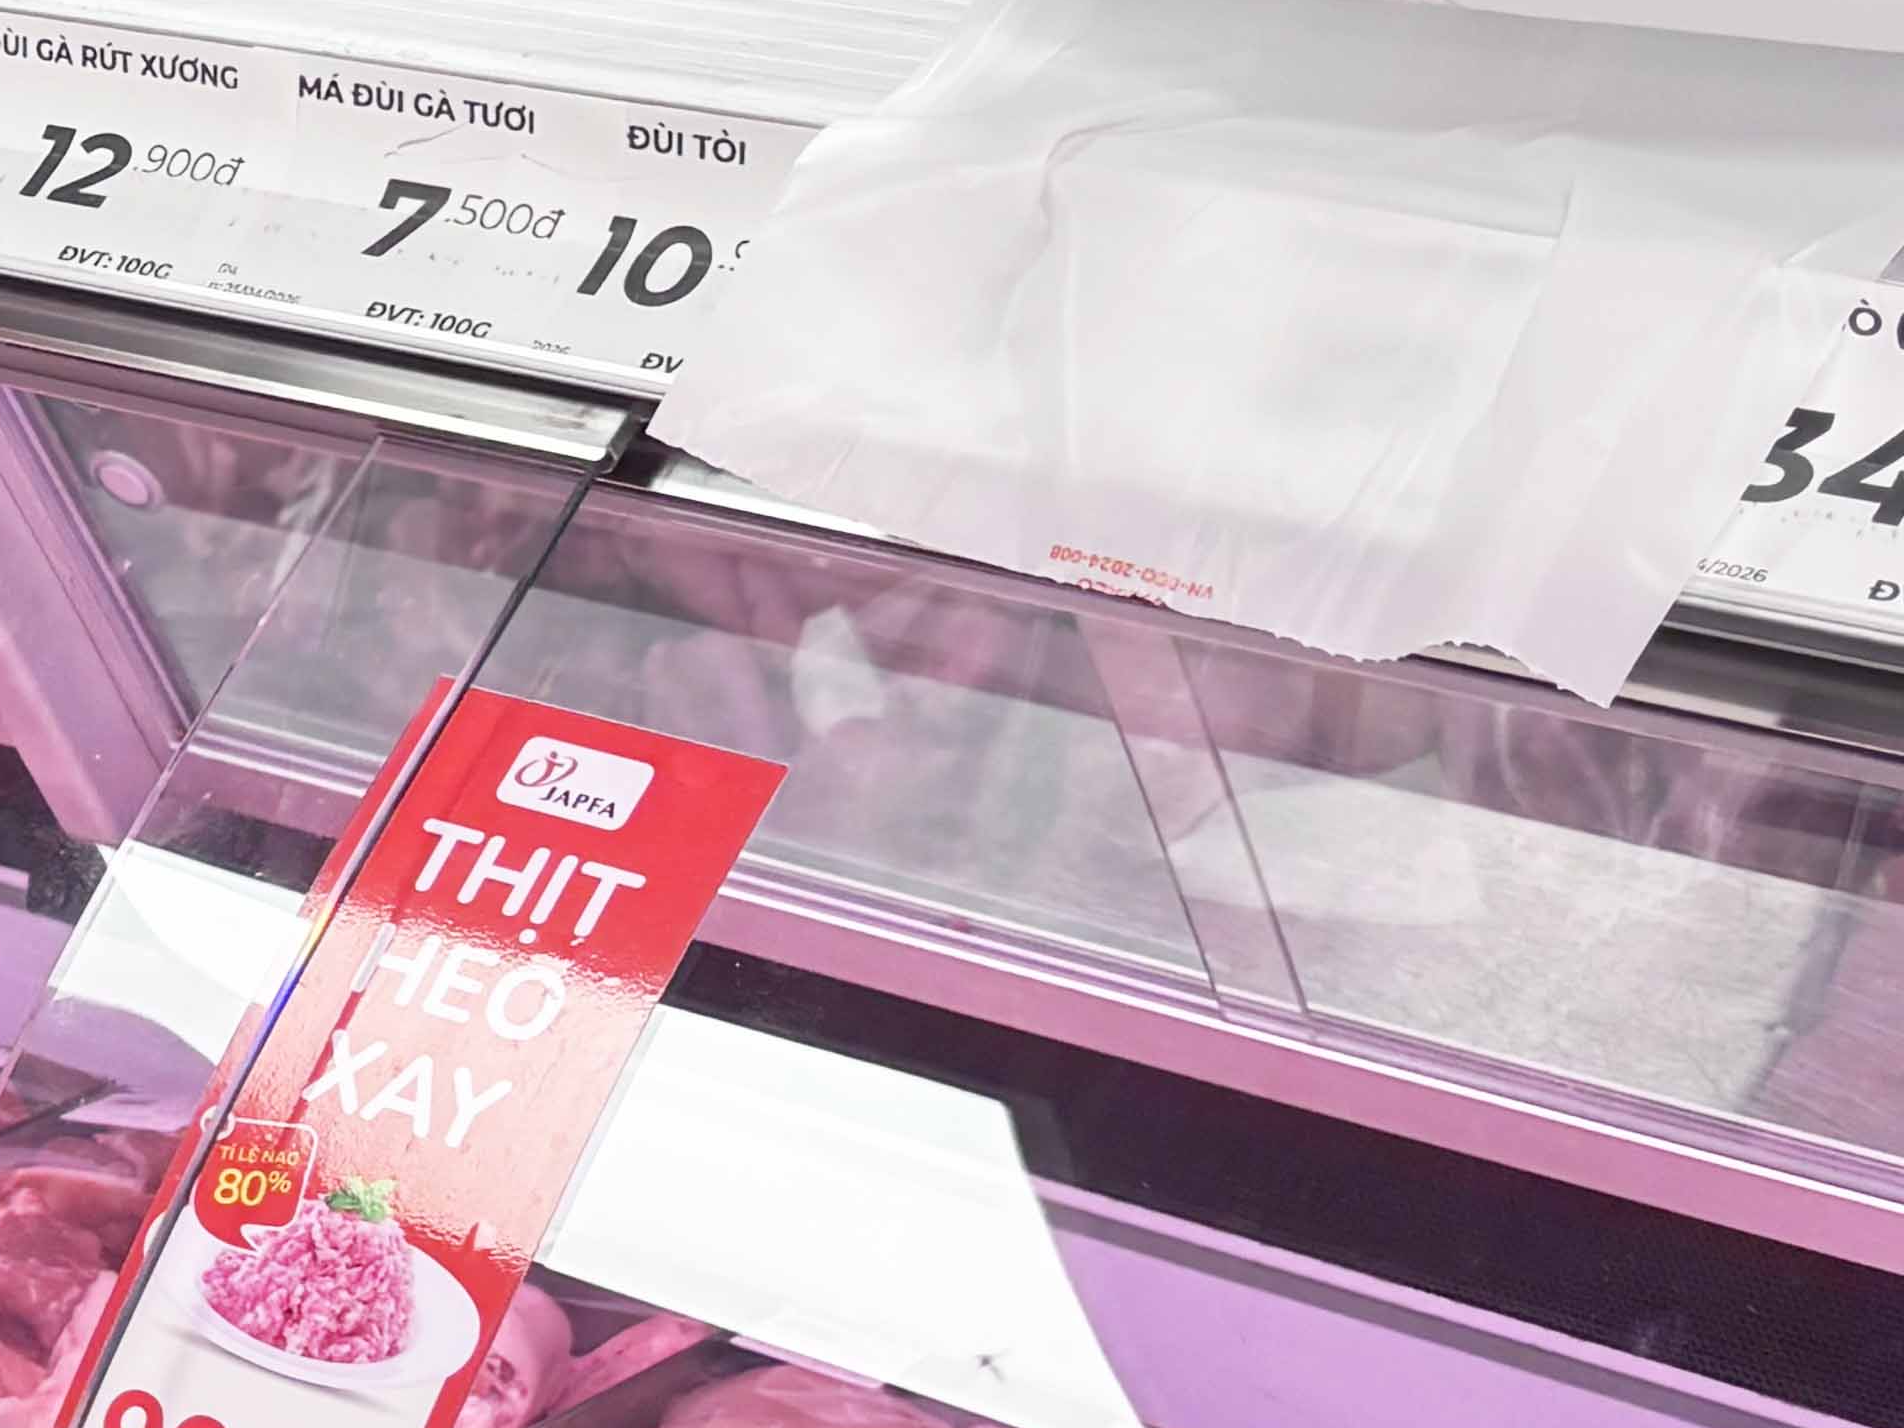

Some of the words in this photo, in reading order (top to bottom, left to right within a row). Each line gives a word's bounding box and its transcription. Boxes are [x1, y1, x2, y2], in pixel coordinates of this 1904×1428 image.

[36, 33, 74, 66] GÀ
[81, 41, 133, 74] RÚT
[140, 52, 239, 90] XƯƠNG
[298, 73, 343, 105] MÁ
[352, 82, 403, 114] ĐÙI
[413, 88, 456, 123] GÀ
[463, 99, 536, 135] TƯƠI
[627, 122, 683, 156] ĐÙI
[57, 246, 113, 271] ĐVT:
[115, 255, 173, 281] 100G
[364, 300, 426, 330] ĐVT:
[428, 312, 492, 340] 100G
[540, 786, 615, 818] JAPFA
[422, 818, 646, 945] THỊT
[352, 922, 566, 1040] HEO
[302, 1029, 512, 1148] XAY
[214, 1168, 292, 1207] 80%
